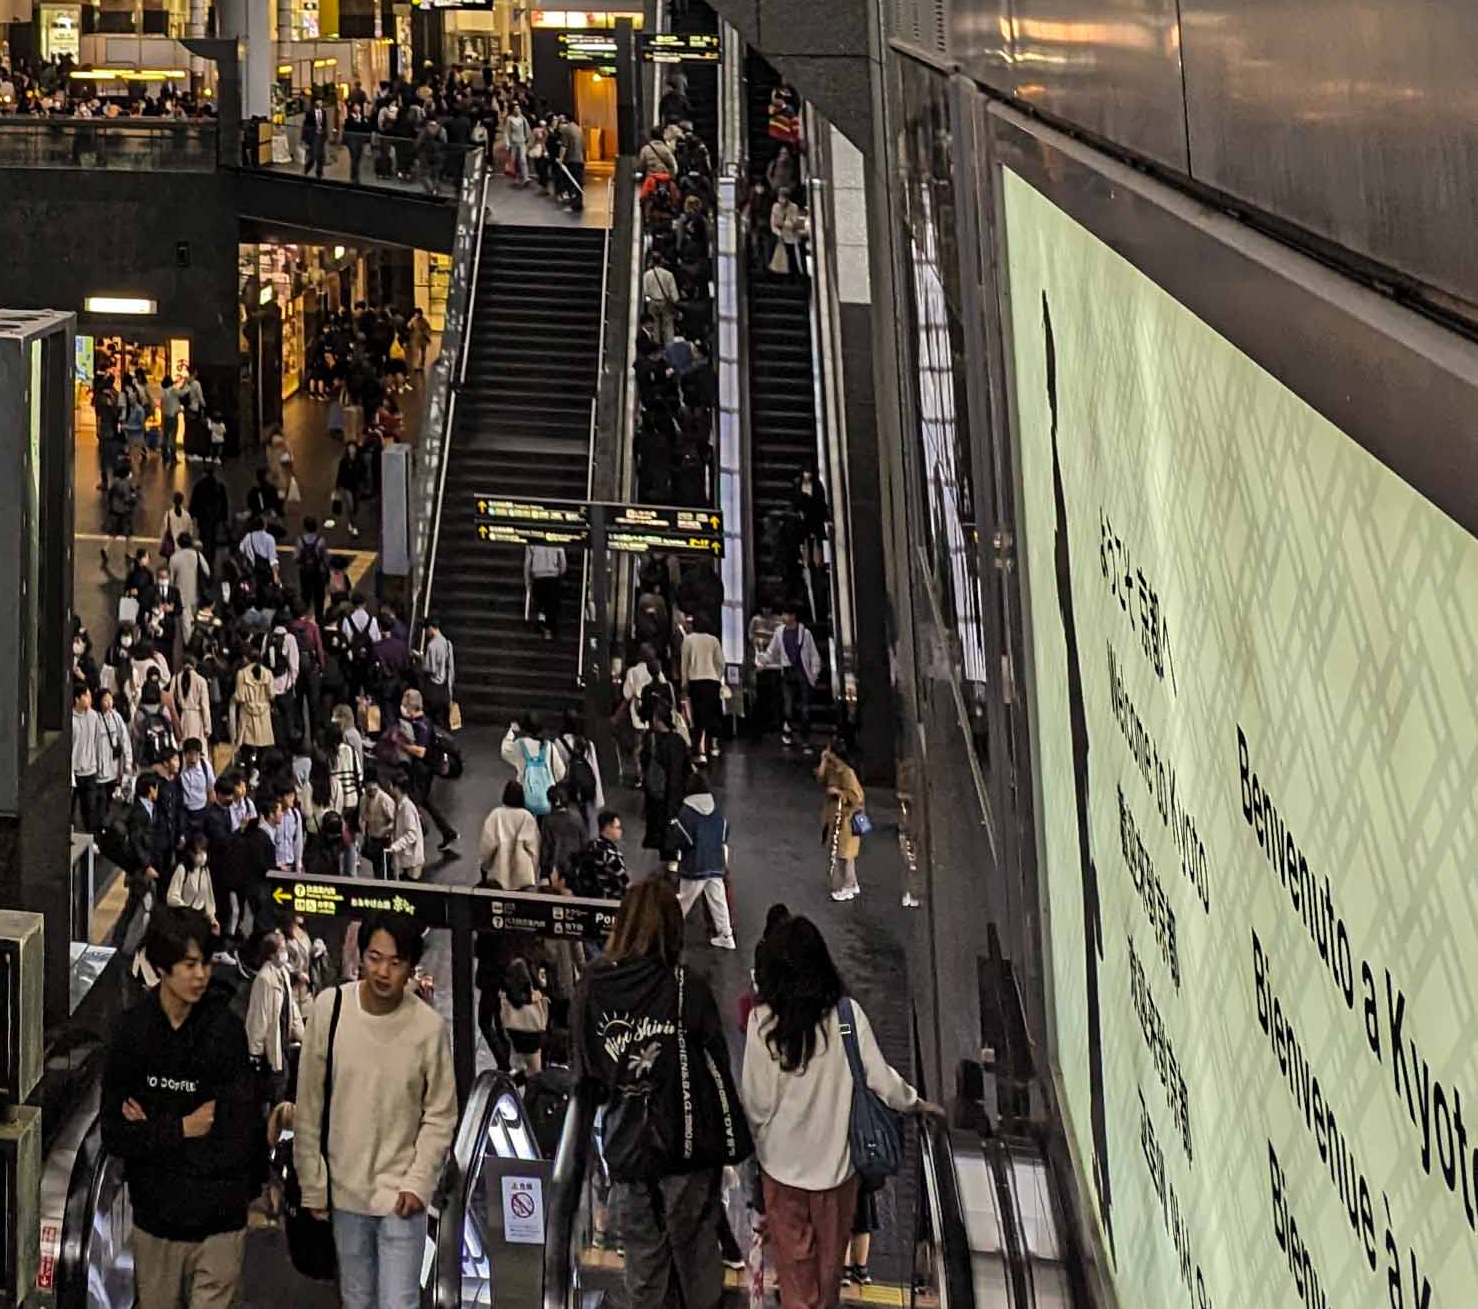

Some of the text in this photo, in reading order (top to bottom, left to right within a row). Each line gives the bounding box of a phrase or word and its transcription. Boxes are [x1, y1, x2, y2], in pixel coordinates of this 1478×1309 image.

[1106, 638, 1210, 915] Welcome to Kyoto
[1236, 722, 1354, 1010] Benvenuto
[1362, 959, 1382, 1064] a
[1251, 926, 1377, 1272] Bienvenue
